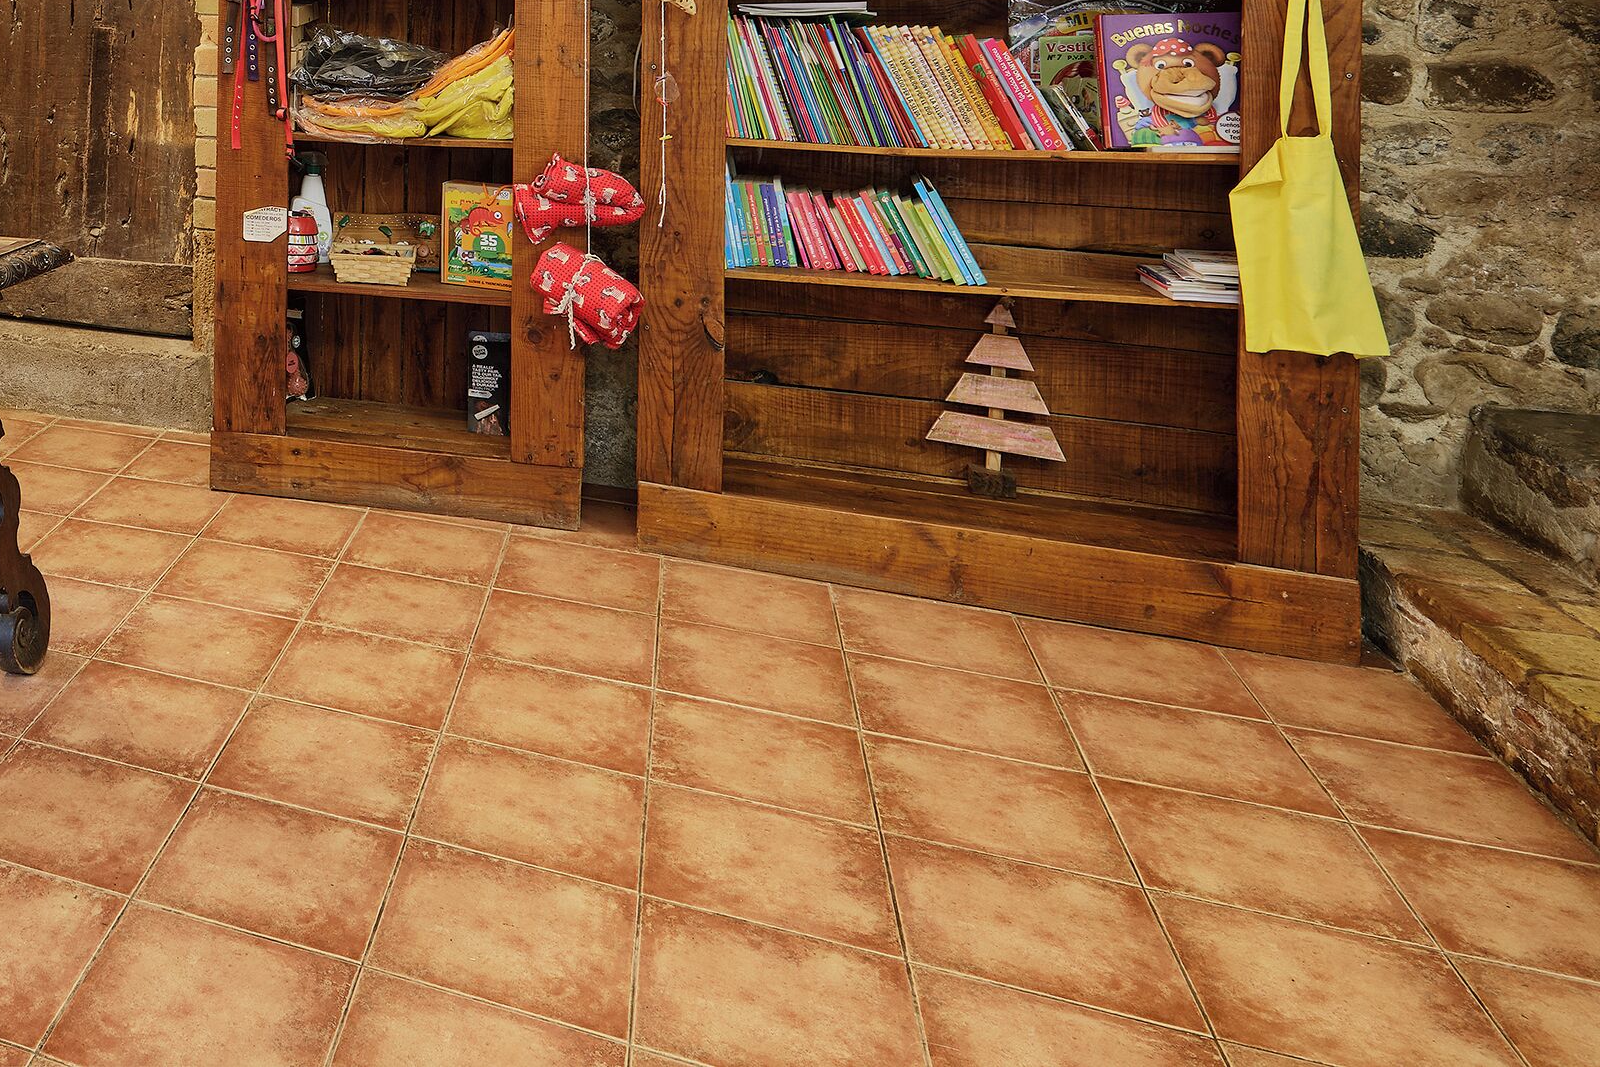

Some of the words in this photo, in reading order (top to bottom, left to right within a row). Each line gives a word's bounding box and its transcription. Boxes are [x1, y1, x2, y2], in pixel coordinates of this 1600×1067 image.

[1110, 22, 1174, 48] Buenas
[1177, 19, 1241, 45] Noches
[1001, 50, 1023, 82] ENCANTADA
[1018, 79, 1031, 95] CASA
[480, 235, 497, 246] 35
